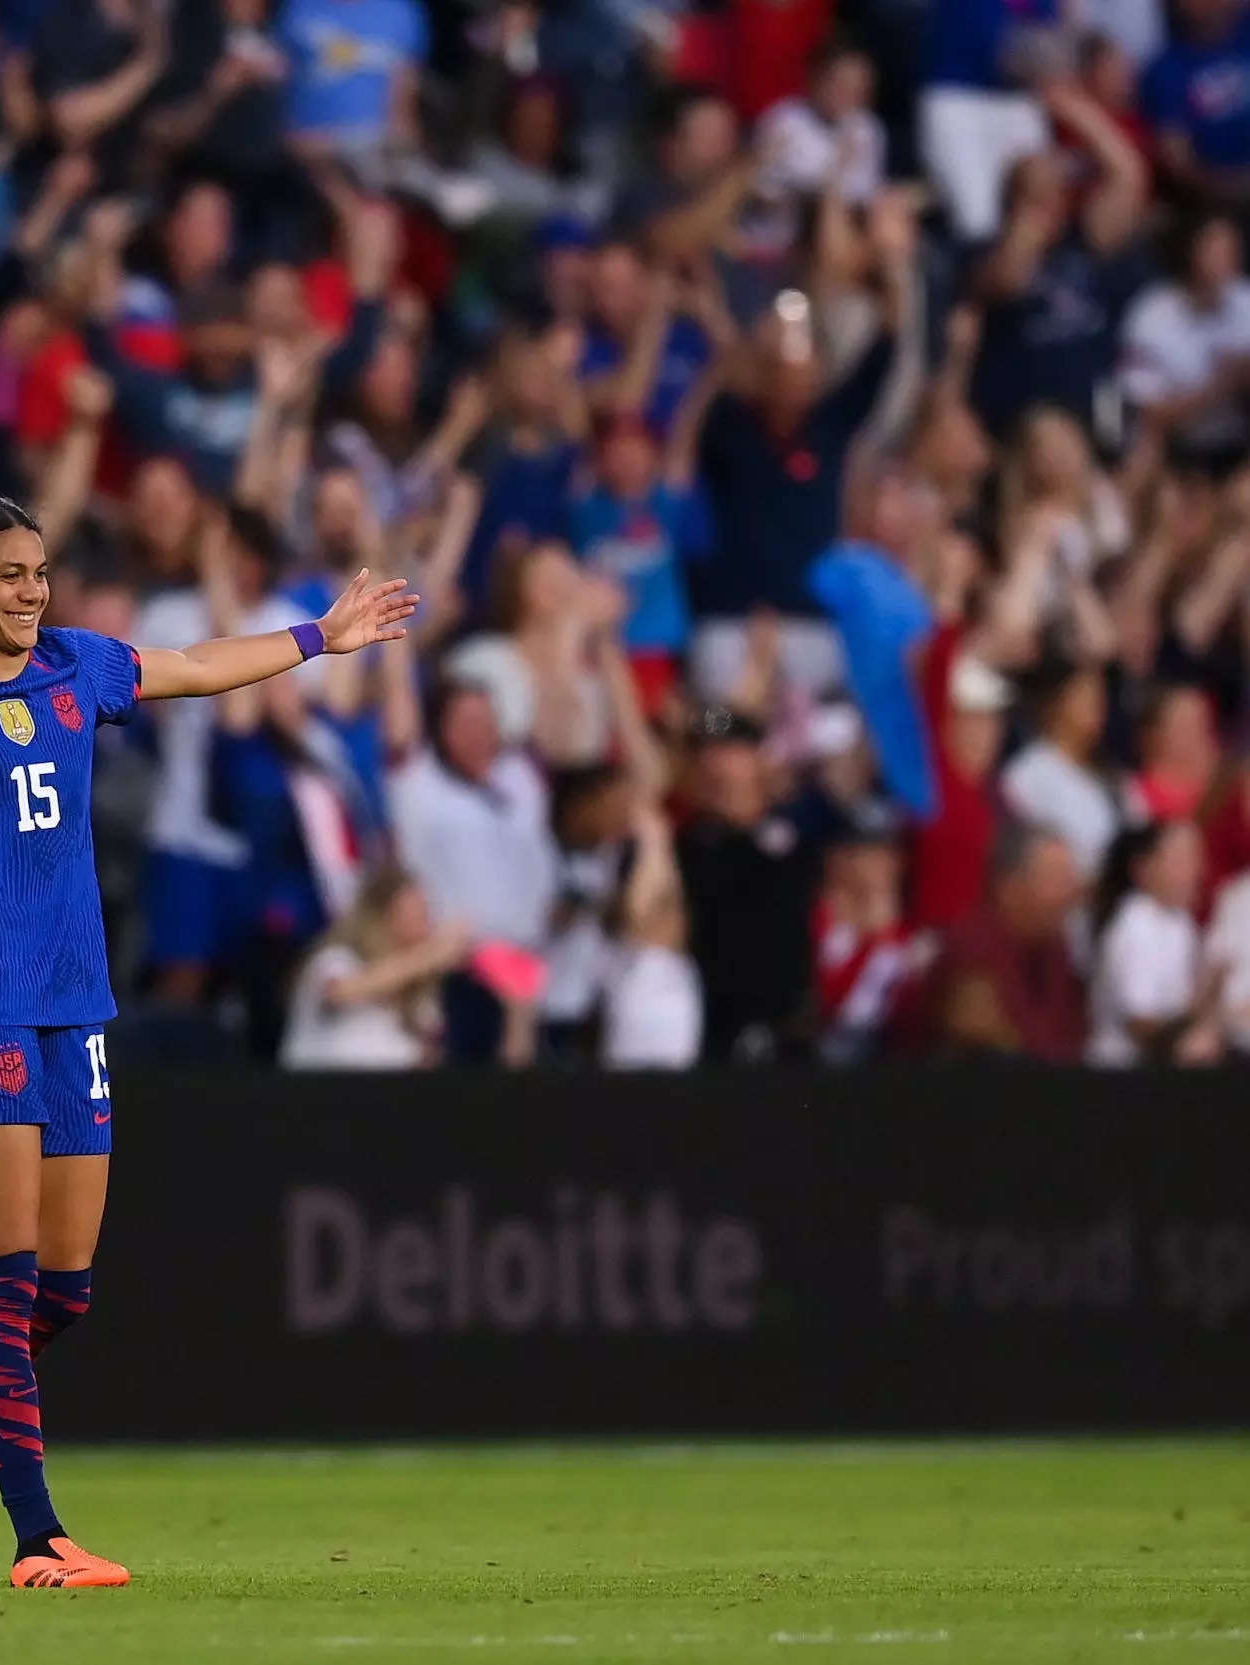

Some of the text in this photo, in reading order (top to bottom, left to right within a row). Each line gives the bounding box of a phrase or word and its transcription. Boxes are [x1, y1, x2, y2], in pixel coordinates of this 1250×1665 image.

[10, 762, 61, 832] 15
[286, 1183, 761, 1329] Deloitte
[882, 1202, 1135, 1307] Proud
